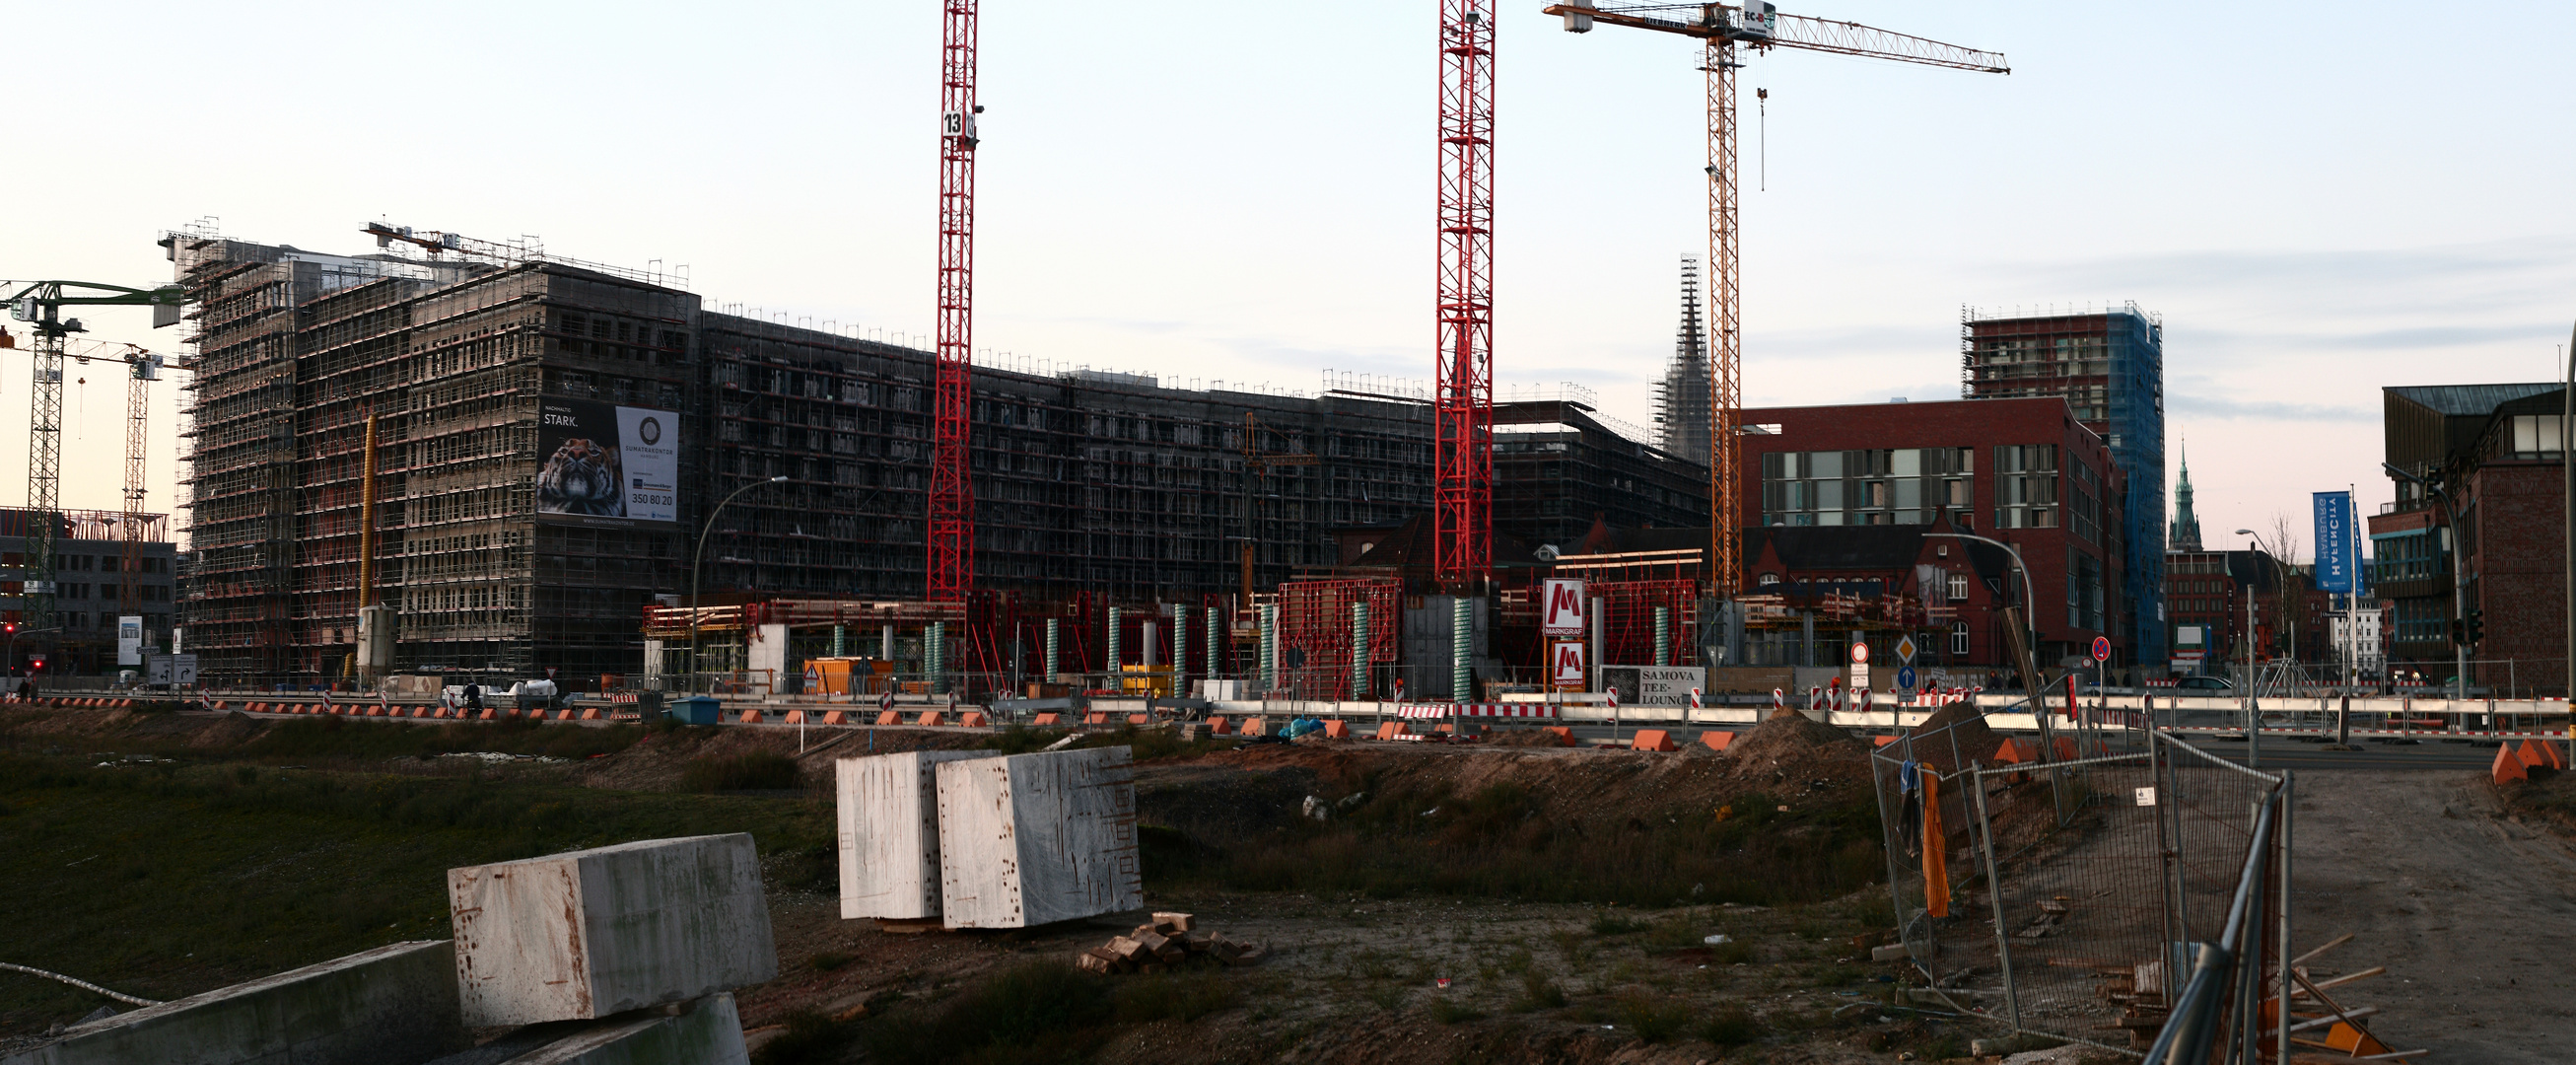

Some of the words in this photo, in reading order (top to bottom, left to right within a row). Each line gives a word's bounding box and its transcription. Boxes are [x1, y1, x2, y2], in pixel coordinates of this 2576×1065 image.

[1645, 17, 1687, 29] LIEBHERR
[1744, 11, 1765, 23] EC-B
[943, 113, 961, 133] 13
[966, 113, 974, 136] 13
[51, 370, 58, 379] 3
[544, 413, 579, 427] STARK.
[625, 445, 673, 455] SUMATRAKONTOR
[632, 493, 648, 504] 350
[650, 494, 661, 505] 80
[661, 495, 672, 506] 20
[1642, 671, 1696, 681] SAMOVA
[1642, 682, 1671, 692] TEE-
